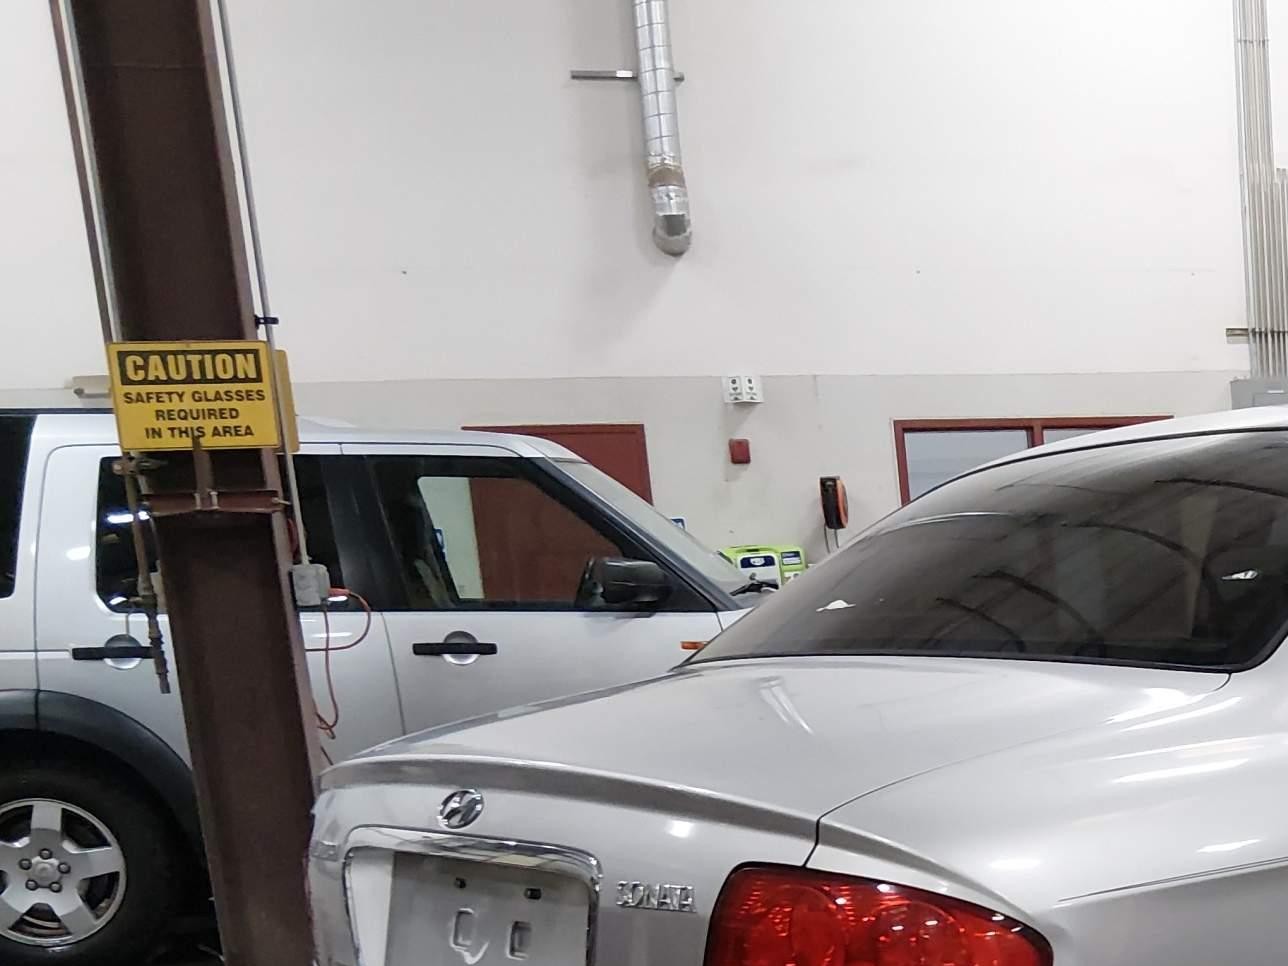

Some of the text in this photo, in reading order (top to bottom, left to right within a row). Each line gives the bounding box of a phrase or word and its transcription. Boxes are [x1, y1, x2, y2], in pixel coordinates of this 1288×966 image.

[125, 353, 257, 381] CAUTION
[123, 389, 266, 404] SAFETY GLASSES
[155, 407, 240, 421] REQUIRED
[145, 425, 255, 439] IN THIS AREA
[615, 880, 698, 913] SONATA
